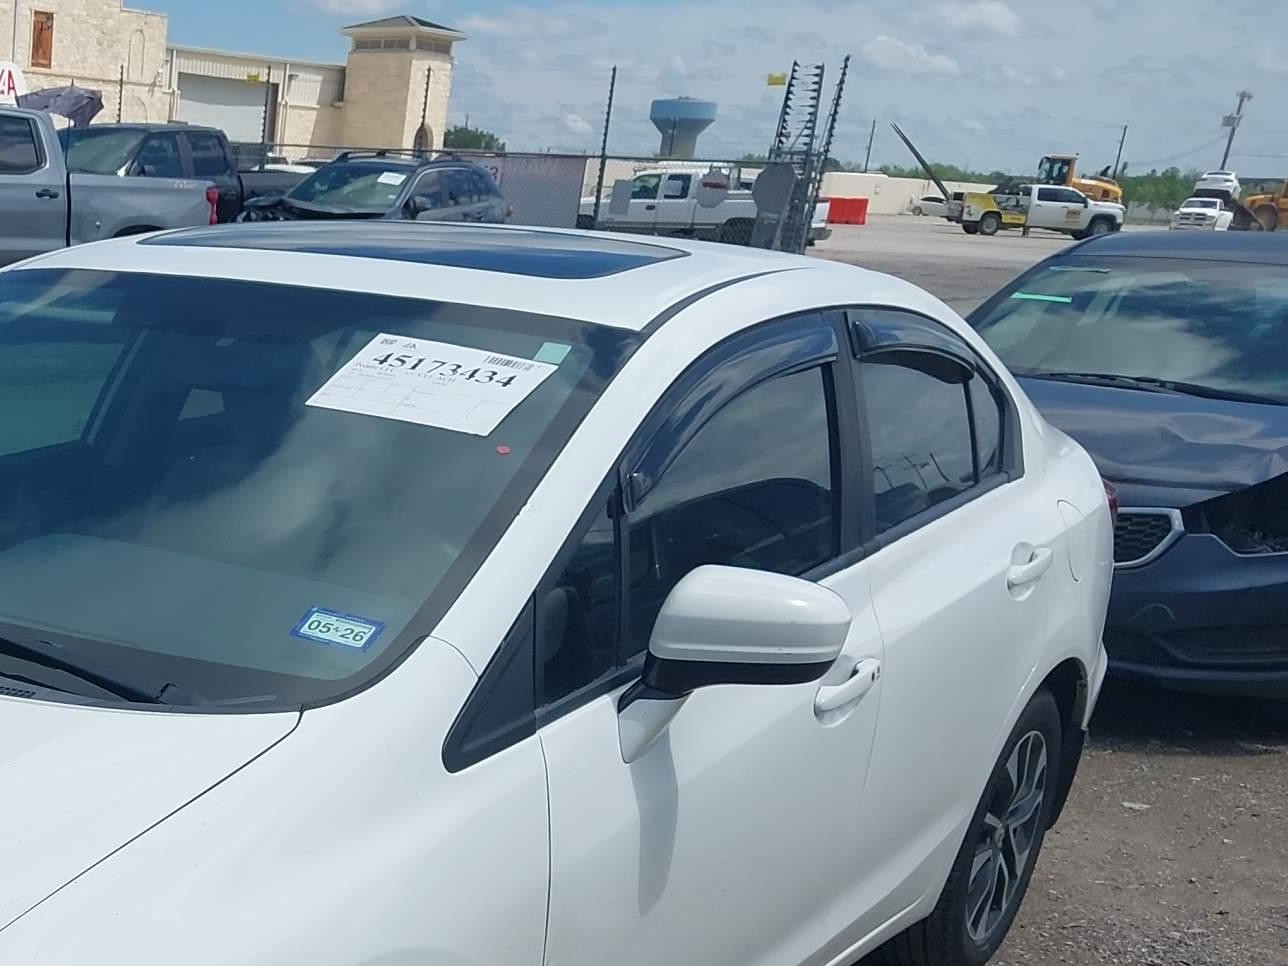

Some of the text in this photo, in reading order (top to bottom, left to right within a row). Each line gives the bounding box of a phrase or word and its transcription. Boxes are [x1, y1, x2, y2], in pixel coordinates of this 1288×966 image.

[373, 352, 517, 388] 45173434
[307, 619, 367, 642] 05 26
